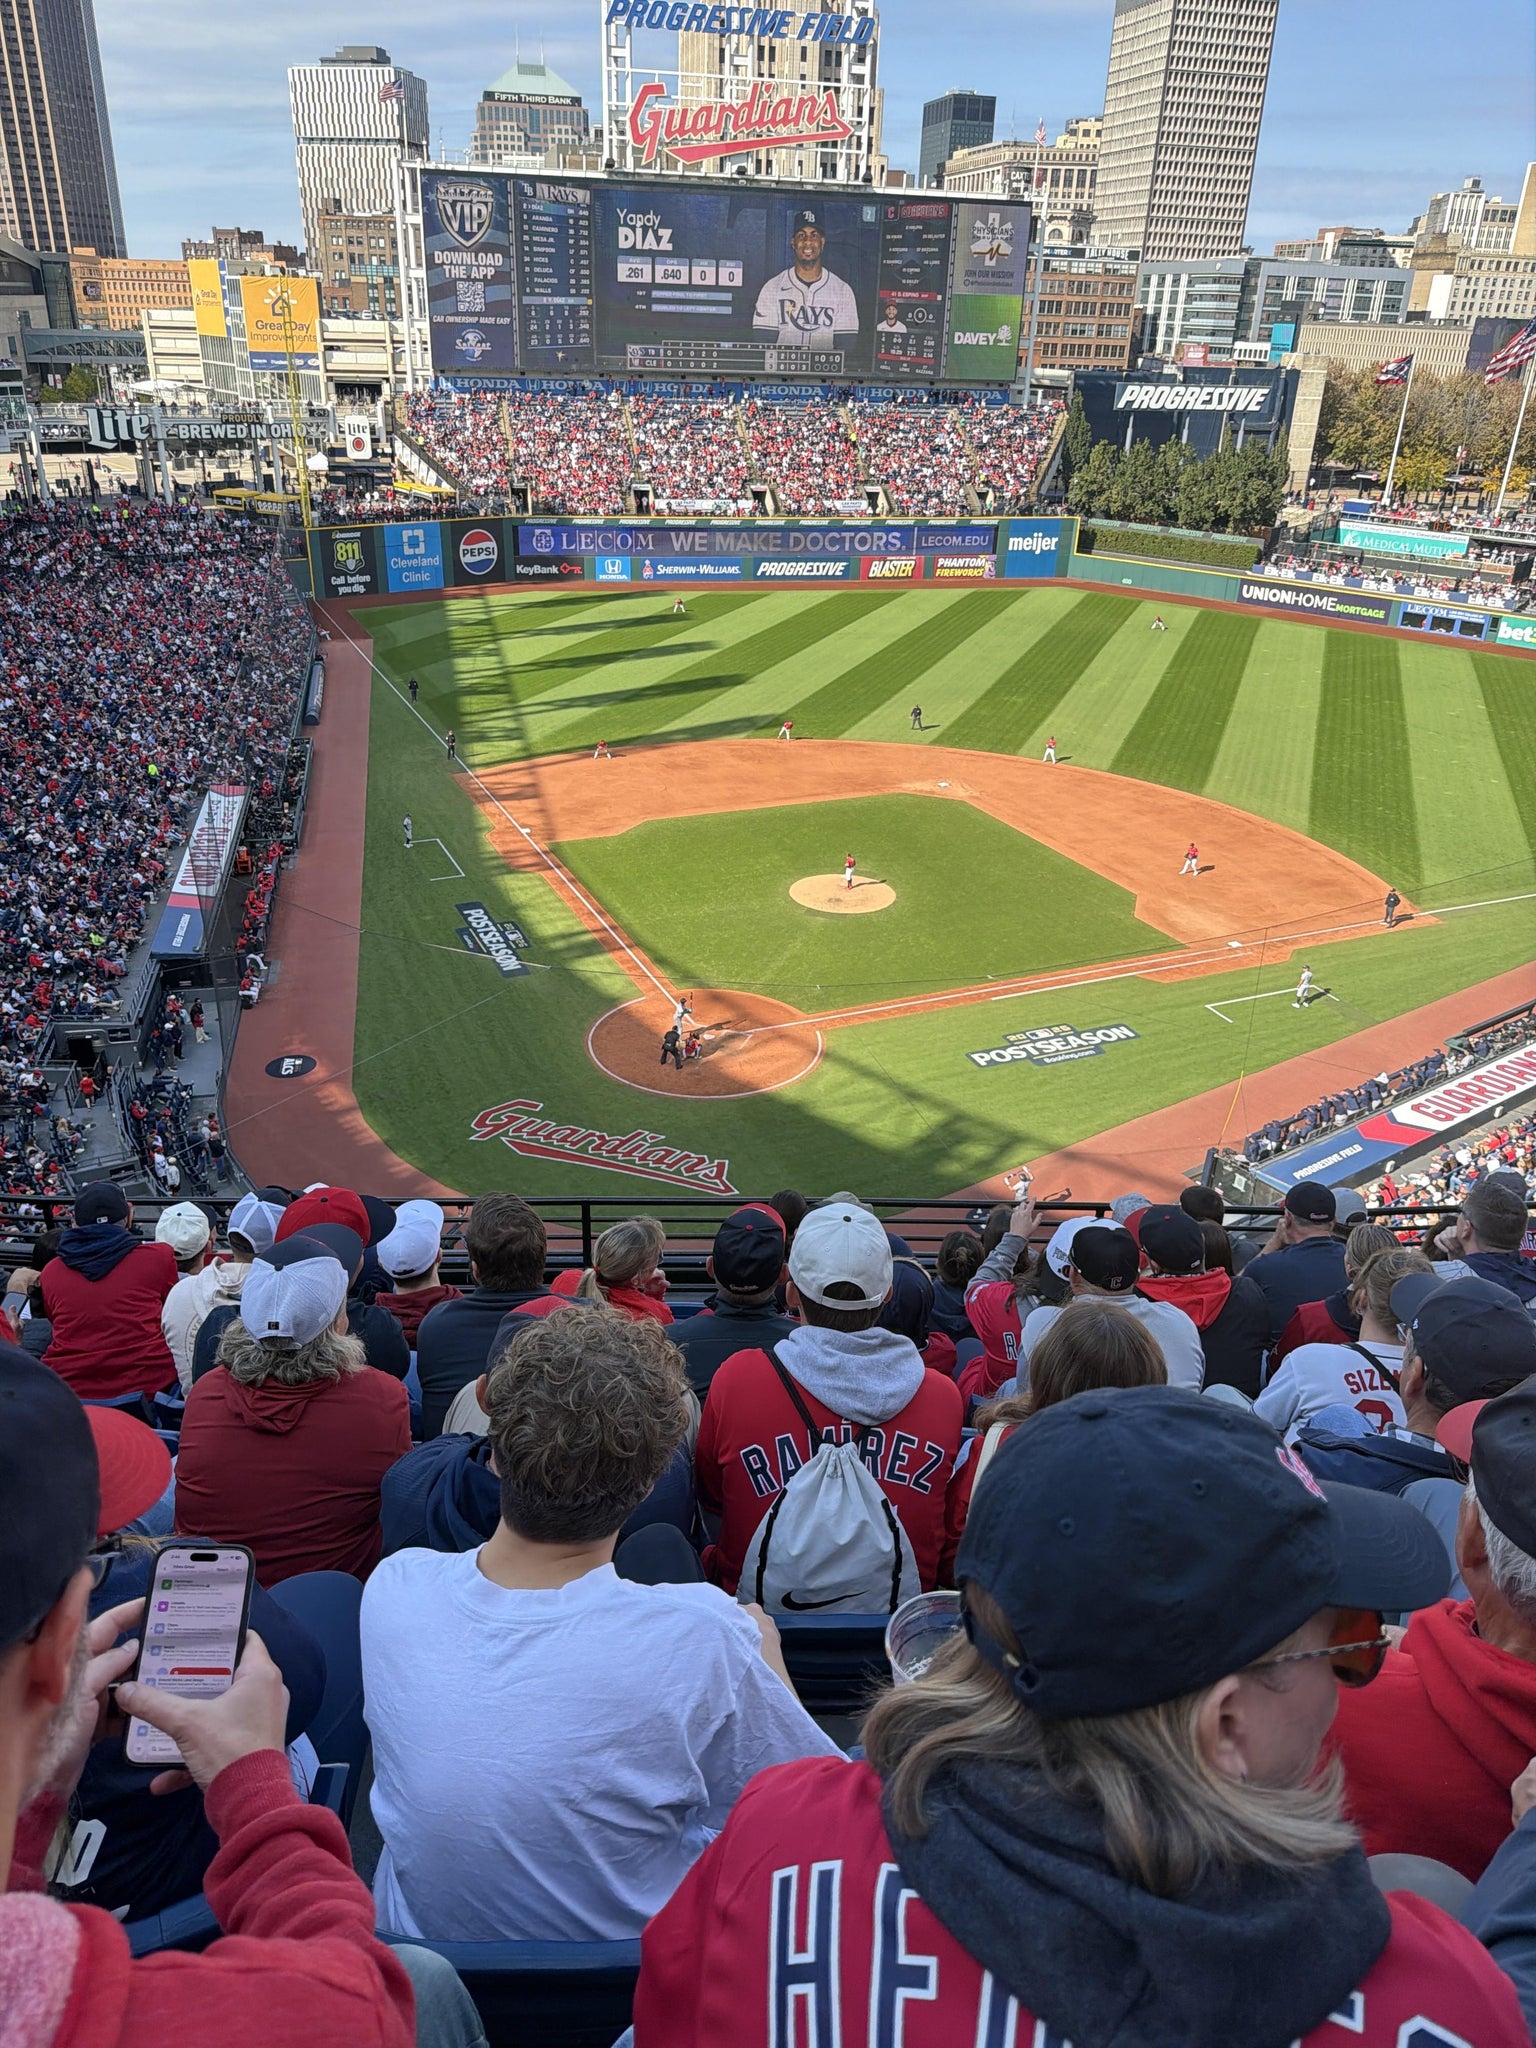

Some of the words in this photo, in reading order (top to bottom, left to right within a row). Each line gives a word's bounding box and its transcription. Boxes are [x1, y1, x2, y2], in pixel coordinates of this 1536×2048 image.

[605, 1, 795, 38] PROGRESSIVE
[797, 12, 876, 45] FIELD
[494, 92, 519, 102] FIFTH
[520, 94, 547, 104] THIRD
[548, 96, 572, 105] BANK
[627, 82, 854, 165] Guardians
[547, 185, 578, 203] RAYS
[442, 201, 488, 233] VIP
[616, 208, 661, 228] Yandy
[803, 210, 816, 223] TB
[888, 206, 895, 219] C
[901, 204, 945, 218] GUARDIANS
[618, 222, 673, 250] DÍAZ
[972, 226, 1014, 237] PHYSICIANS
[434, 250, 503, 266] DOWNLOAD
[1085, 248, 1106, 259] RALLY
[443, 265, 468, 279] THE
[471, 266, 496, 280] APP
[626, 267, 643, 279] .261
[661, 269, 681, 280] .640
[700, 270, 707, 281] 0
[728, 271, 735, 282] 0
[977, 270, 990, 278] OUR
[433, 315, 445, 323] CAR
[445, 315, 479, 323] OWNERSHIP
[479, 316, 496, 324] MADE
[496, 317, 511, 325] EASY
[778, 299, 835, 331] RAYS
[954, 331, 996, 346] DAVEY
[456, 378, 521, 389] HONDA
[1117, 384, 1272, 413] PROGRESSIVE
[222, 413, 264, 423] PROUDLY
[83, 407, 150, 449] Lite
[178, 423, 246, 439] BREWED
[250, 423, 267, 438] IN
[347, 423, 368, 436] Lite
[670, 531, 707, 552] WE
[715, 531, 781, 552] MAKE
[789, 531, 906, 551] DOCTORS.
[921, 535, 989, 548] LECOM.EDU
[1008, 532, 1058, 555] meijer
[1363, 536, 1411, 553] MEDICAL
[336, 541, 360, 561] 811
[462, 546, 495, 558] PEPSI
[391, 555, 440, 569] Cleveland
[756, 562, 848, 577] PROGRESSIVE
[868, 560, 915, 578] BLASTER
[937, 558, 986, 568] PHANTOM
[402, 570, 431, 583] Clinic
[516, 564, 559, 576] KeyBank
[936, 568, 984, 577] FIREWORKS
[331, 575, 346, 586] Call
[347, 574, 371, 584] before
[338, 586, 352, 596] you
[352, 583, 366, 594] dig.
[1336, 604, 1385, 619] MORTGAGE
[463, 908, 522, 971] POSTSEASON
[970, 1025, 1136, 1067] POSTSEASON
[1043, 1049, 1096, 1064] Booking.com
[469, 1098, 740, 1196] Guardians
[1339, 1143, 1364, 1159] FIELD
[1110, 1276, 1122, 1289] C
